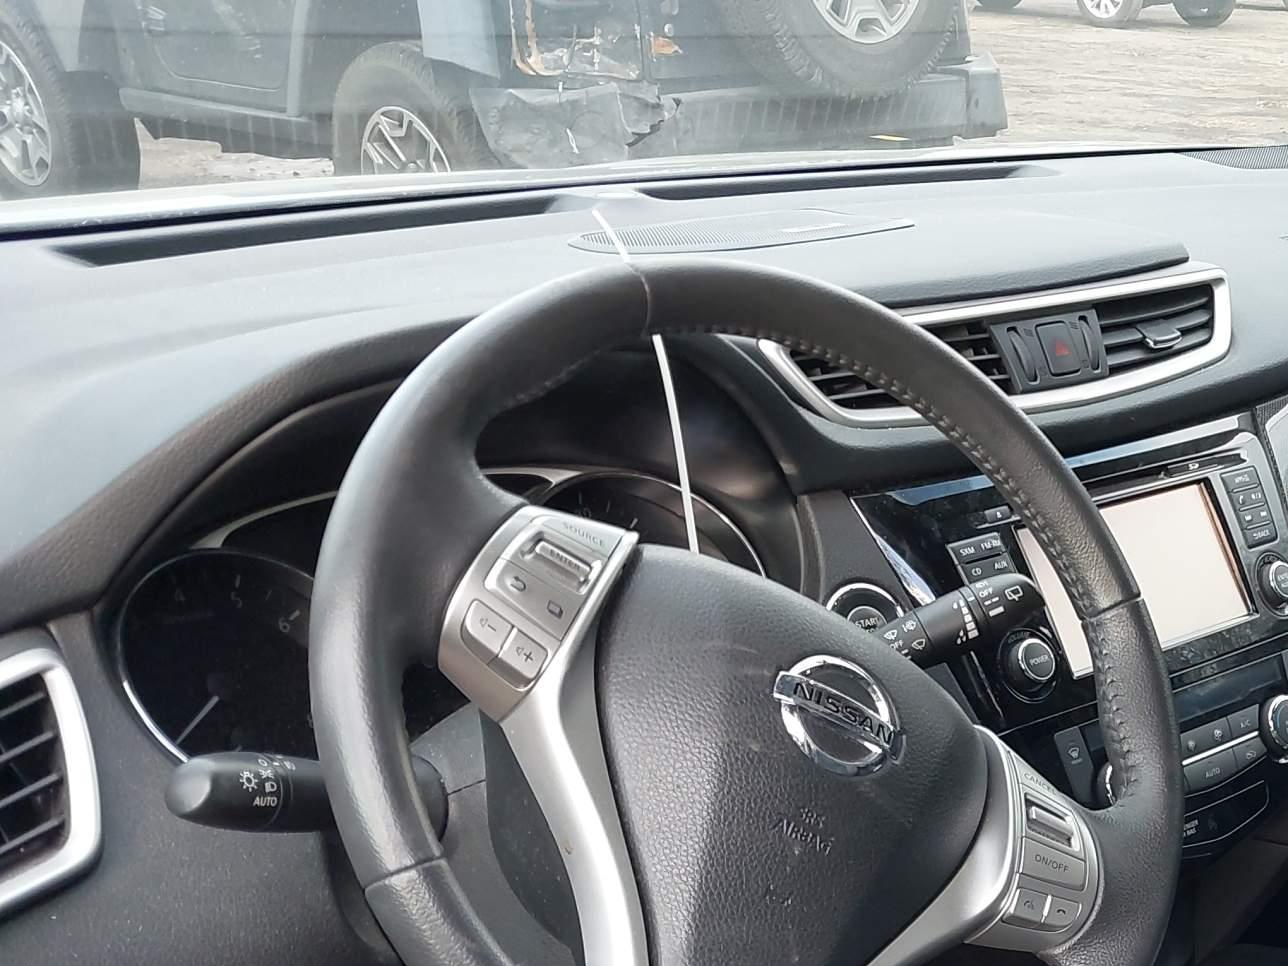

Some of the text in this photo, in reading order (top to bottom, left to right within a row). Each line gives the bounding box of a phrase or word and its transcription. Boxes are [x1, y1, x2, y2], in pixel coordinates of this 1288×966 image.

[562, 521, 606, 547] SOURCE
[549, 548, 582, 571] ENTER
[971, 560, 1008, 576] CD AUX
[1029, 654, 1049, 667] POWER
[793, 681, 893, 747] NISSAN
[1204, 767, 1221, 779] AUTO
[1023, 772, 1056, 795] CANCEL
[252, 796, 278, 808] AUTO
[1034, 853, 1071, 873] ON/OFF
